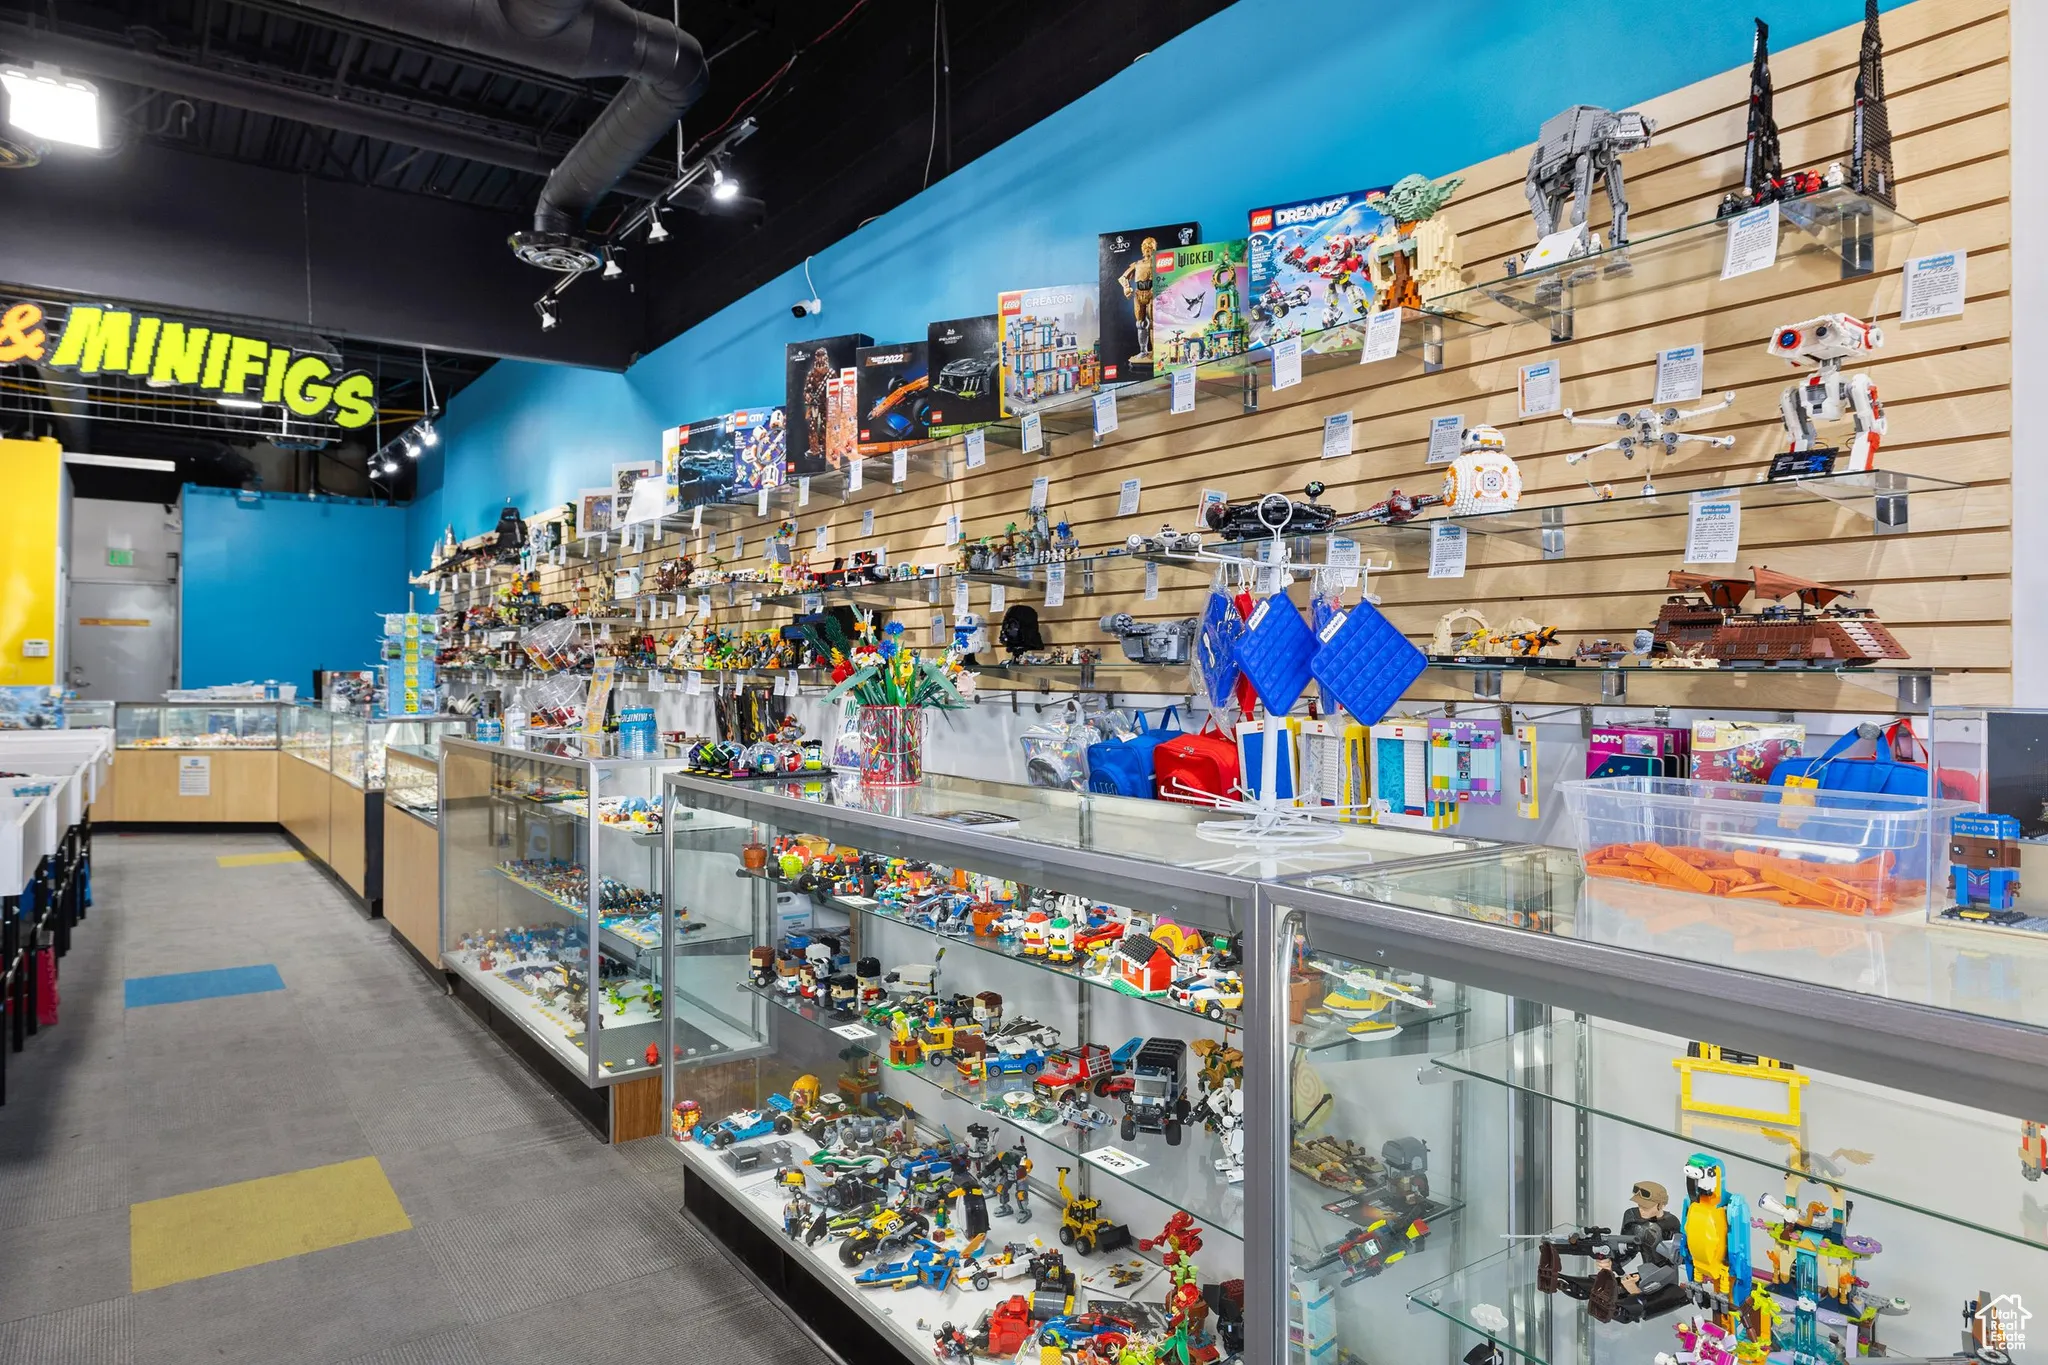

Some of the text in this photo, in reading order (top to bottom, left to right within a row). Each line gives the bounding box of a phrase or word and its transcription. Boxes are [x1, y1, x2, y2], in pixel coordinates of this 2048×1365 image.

[1252, 214, 1272, 227] LEGO
[1109, 242, 1131, 251] C-3PO
[1251, 239, 1263, 247] 9+
[1156, 250, 1214, 268] LEGO WICKED
[1003, 294, 1073, 310] LEGO CREATOR
[884, 353, 904, 364] 2022
[51, 306, 376, 429] MINIFIGS
[749, 412, 764, 422] CITY
[1450, 721, 1477, 730] DOTS
[1592, 733, 1622, 744] DOTS
[1698, 730, 1716, 738] LEGO
